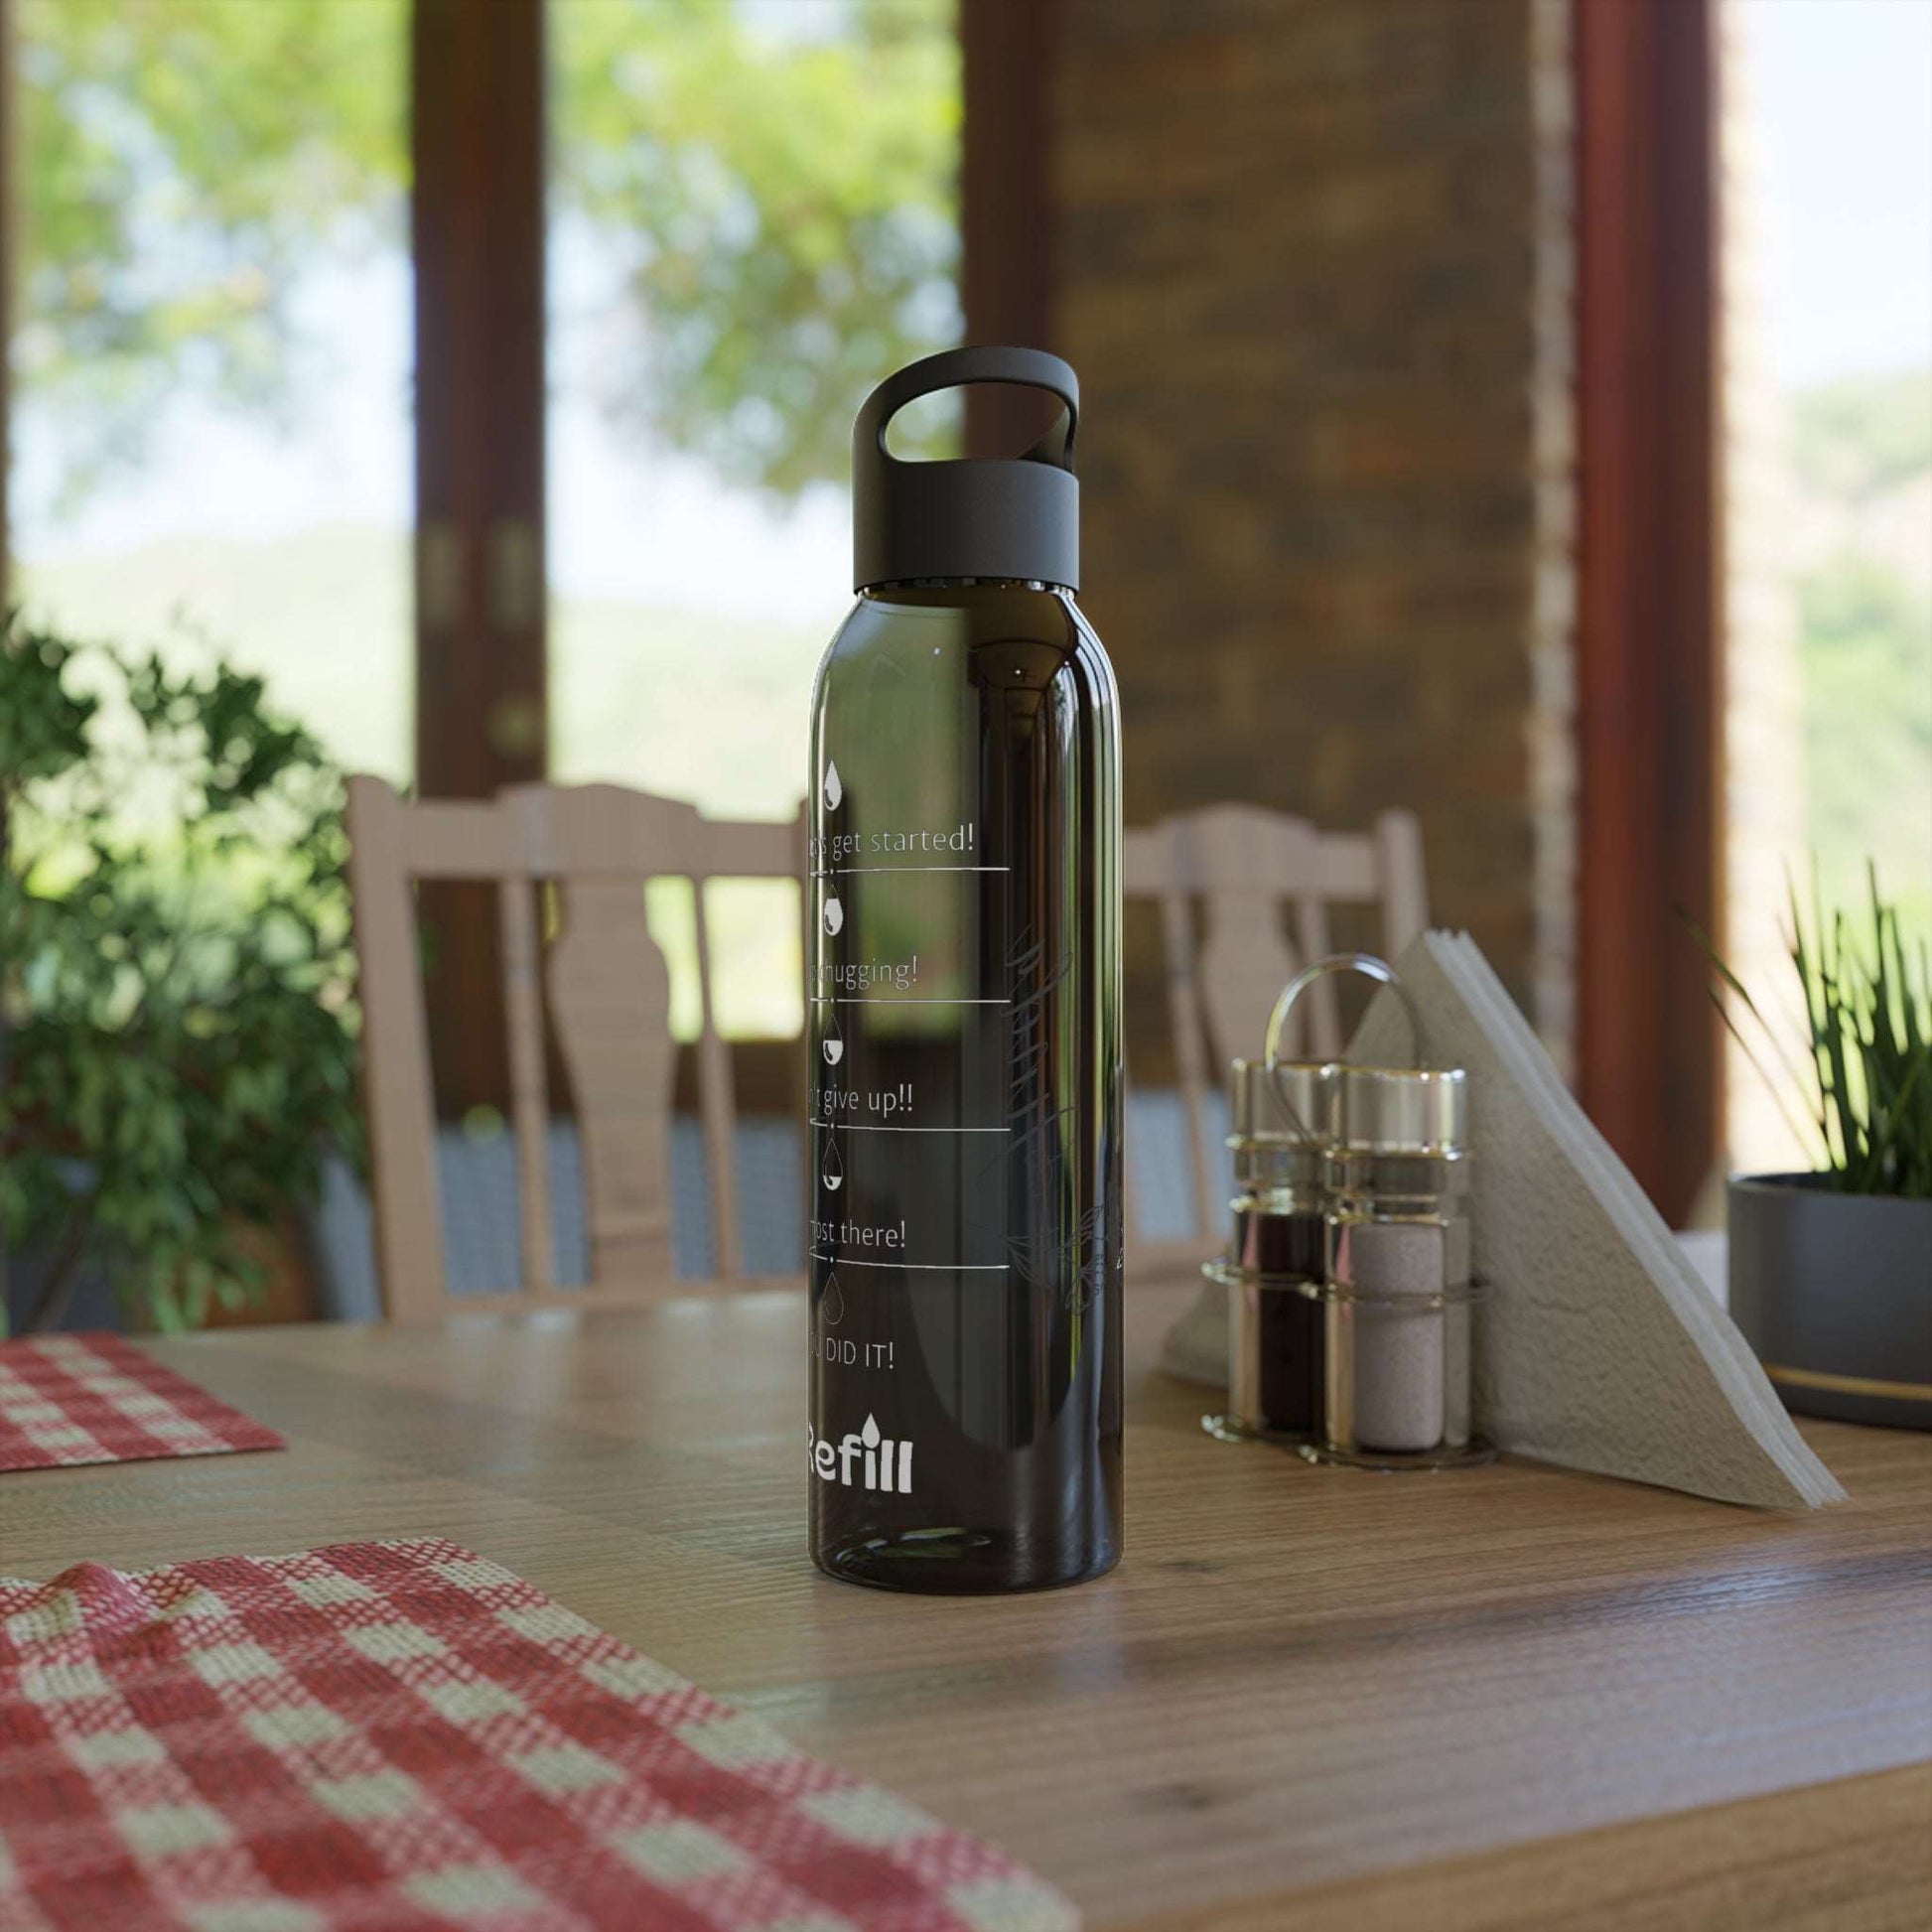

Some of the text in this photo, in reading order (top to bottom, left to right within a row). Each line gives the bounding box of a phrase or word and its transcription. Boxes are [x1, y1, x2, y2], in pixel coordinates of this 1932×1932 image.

[833, 832, 861, 862] get
[871, 822, 974, 852] started!
[823, 1083, 859, 1116] give
[868, 1083, 913, 1119] up!!
[840, 1218, 905, 1249] there!
[826, 1336, 857, 1365] DID
[866, 1341, 895, 1370] IT!
